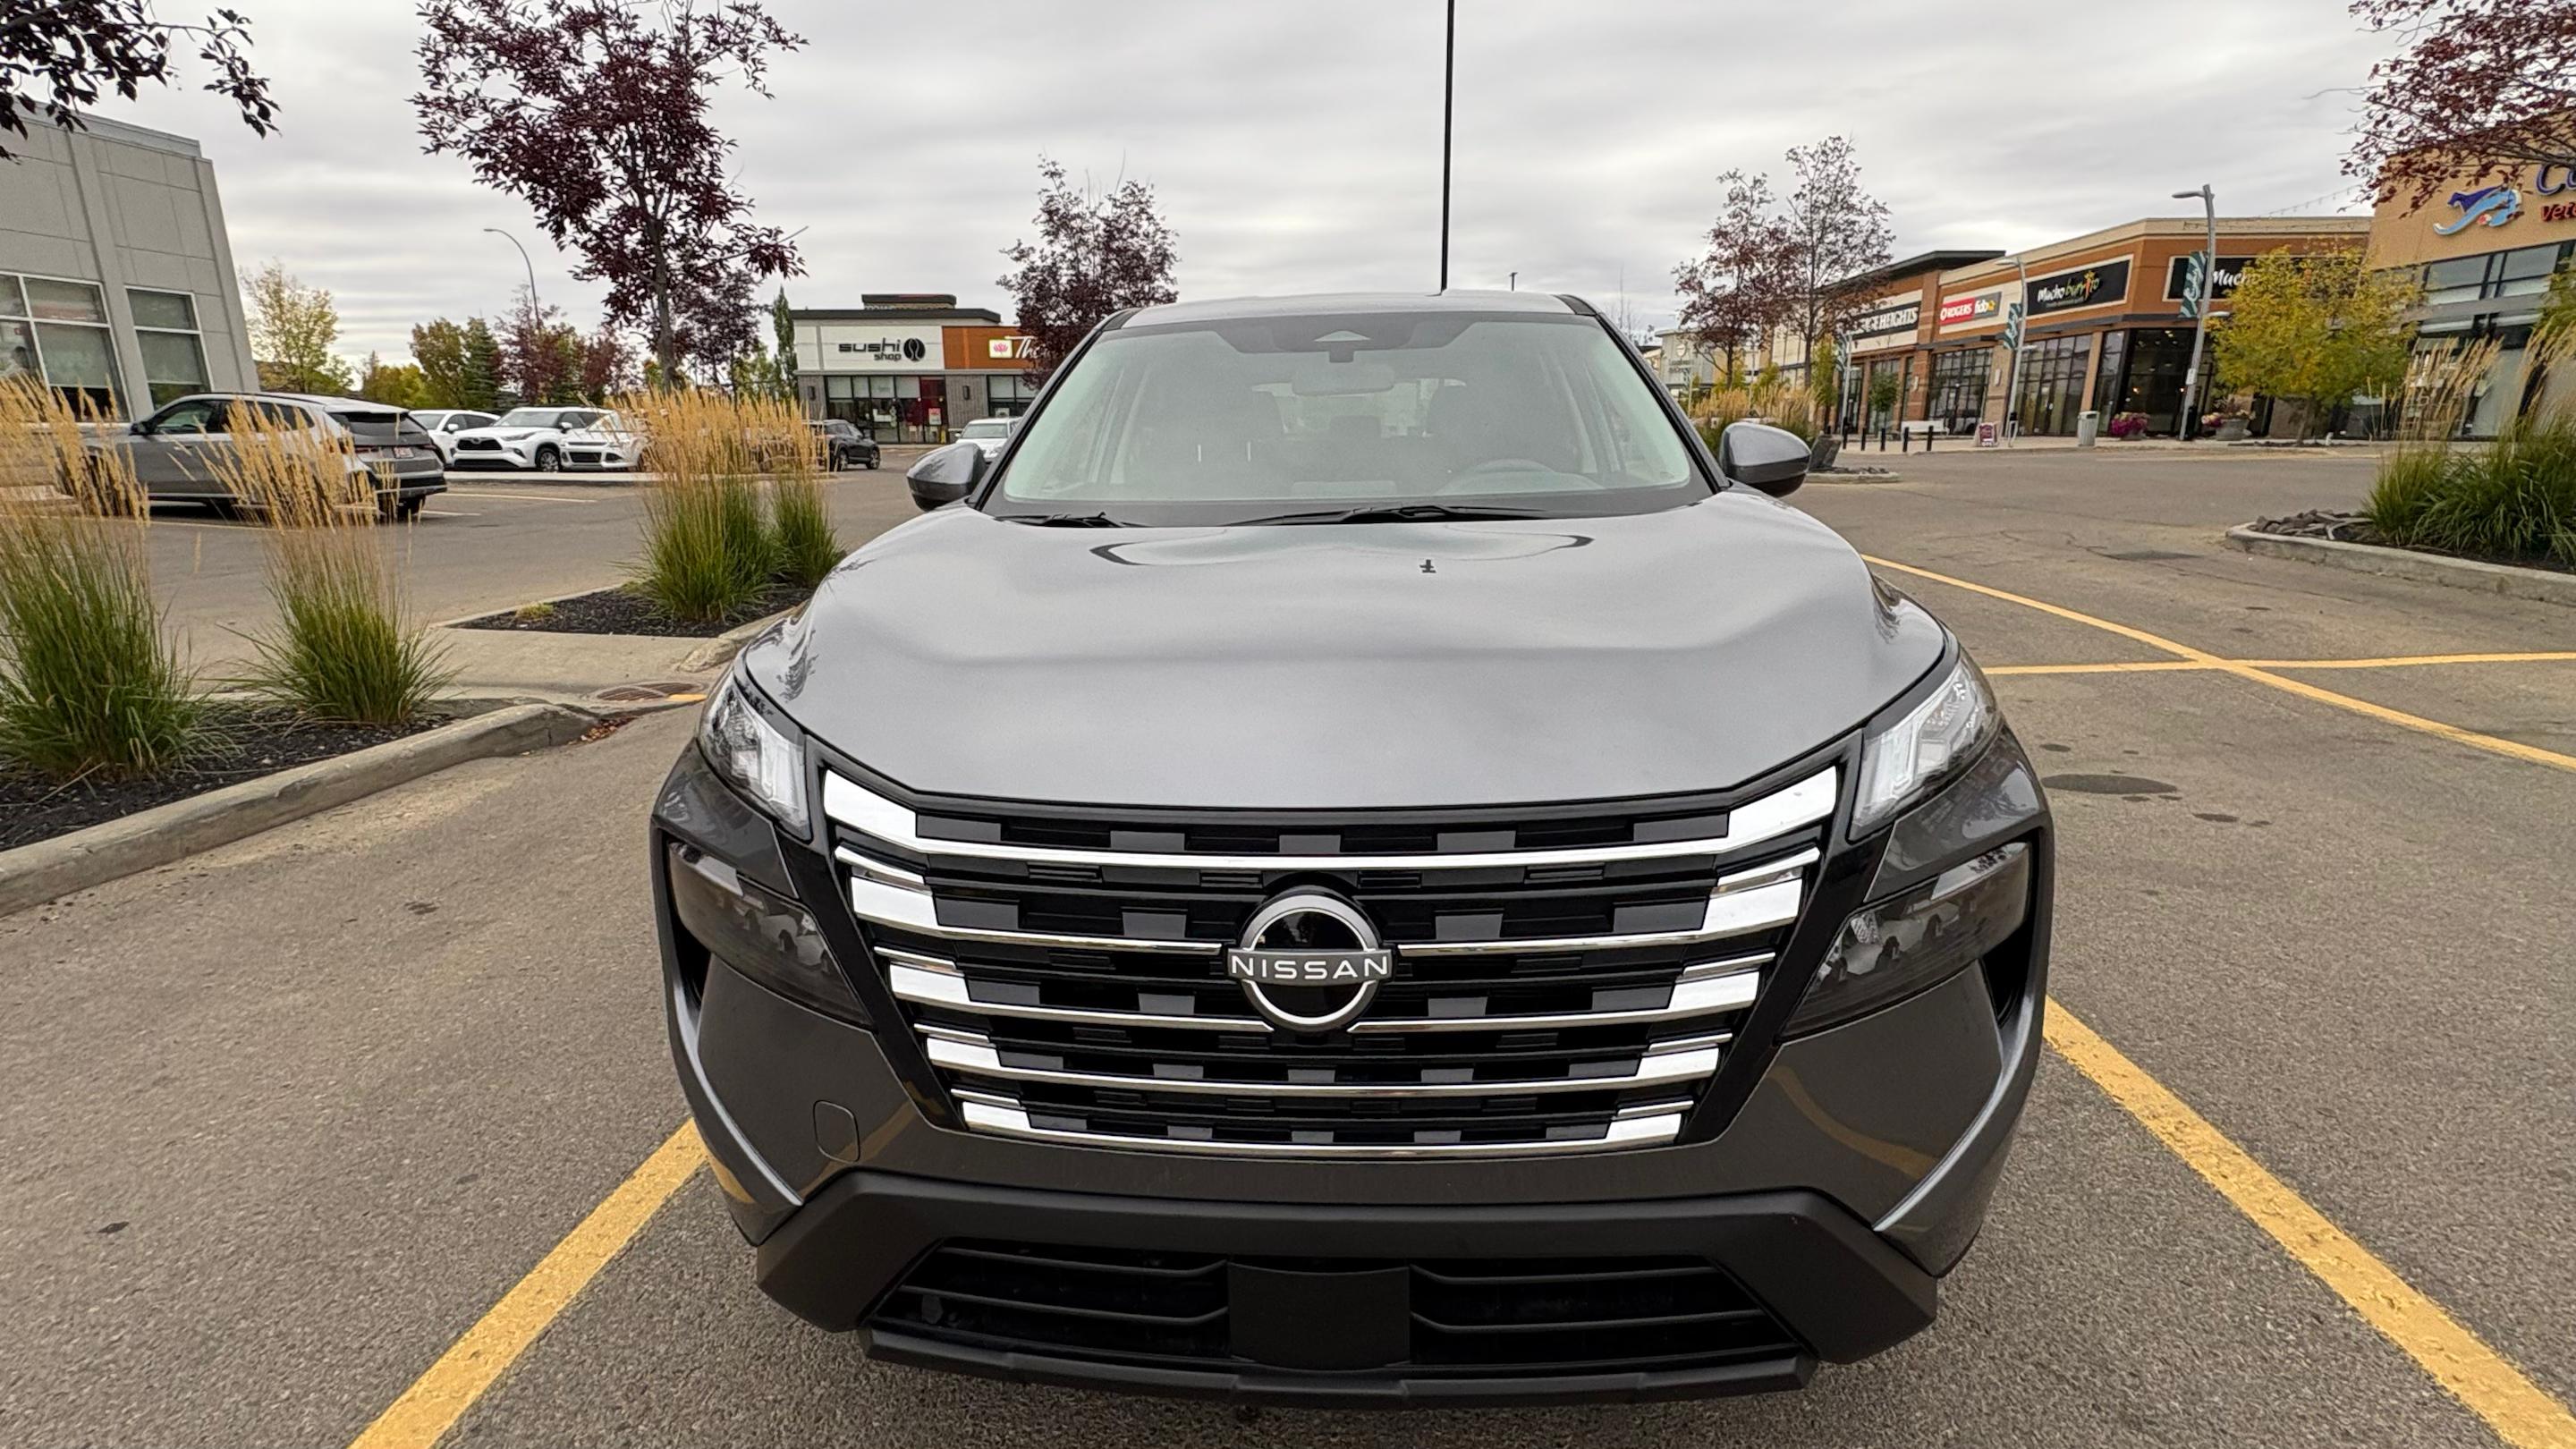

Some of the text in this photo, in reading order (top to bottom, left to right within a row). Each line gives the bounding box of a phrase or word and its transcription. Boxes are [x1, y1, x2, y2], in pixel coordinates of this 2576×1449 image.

[1946, 303, 1972, 318] ROGERS
[1879, 307, 1919, 330] HEIGHTS
[838, 337, 901, 352] sushi
[874, 352, 902, 361] shop
[1231, 955, 1388, 980] NISSAN
